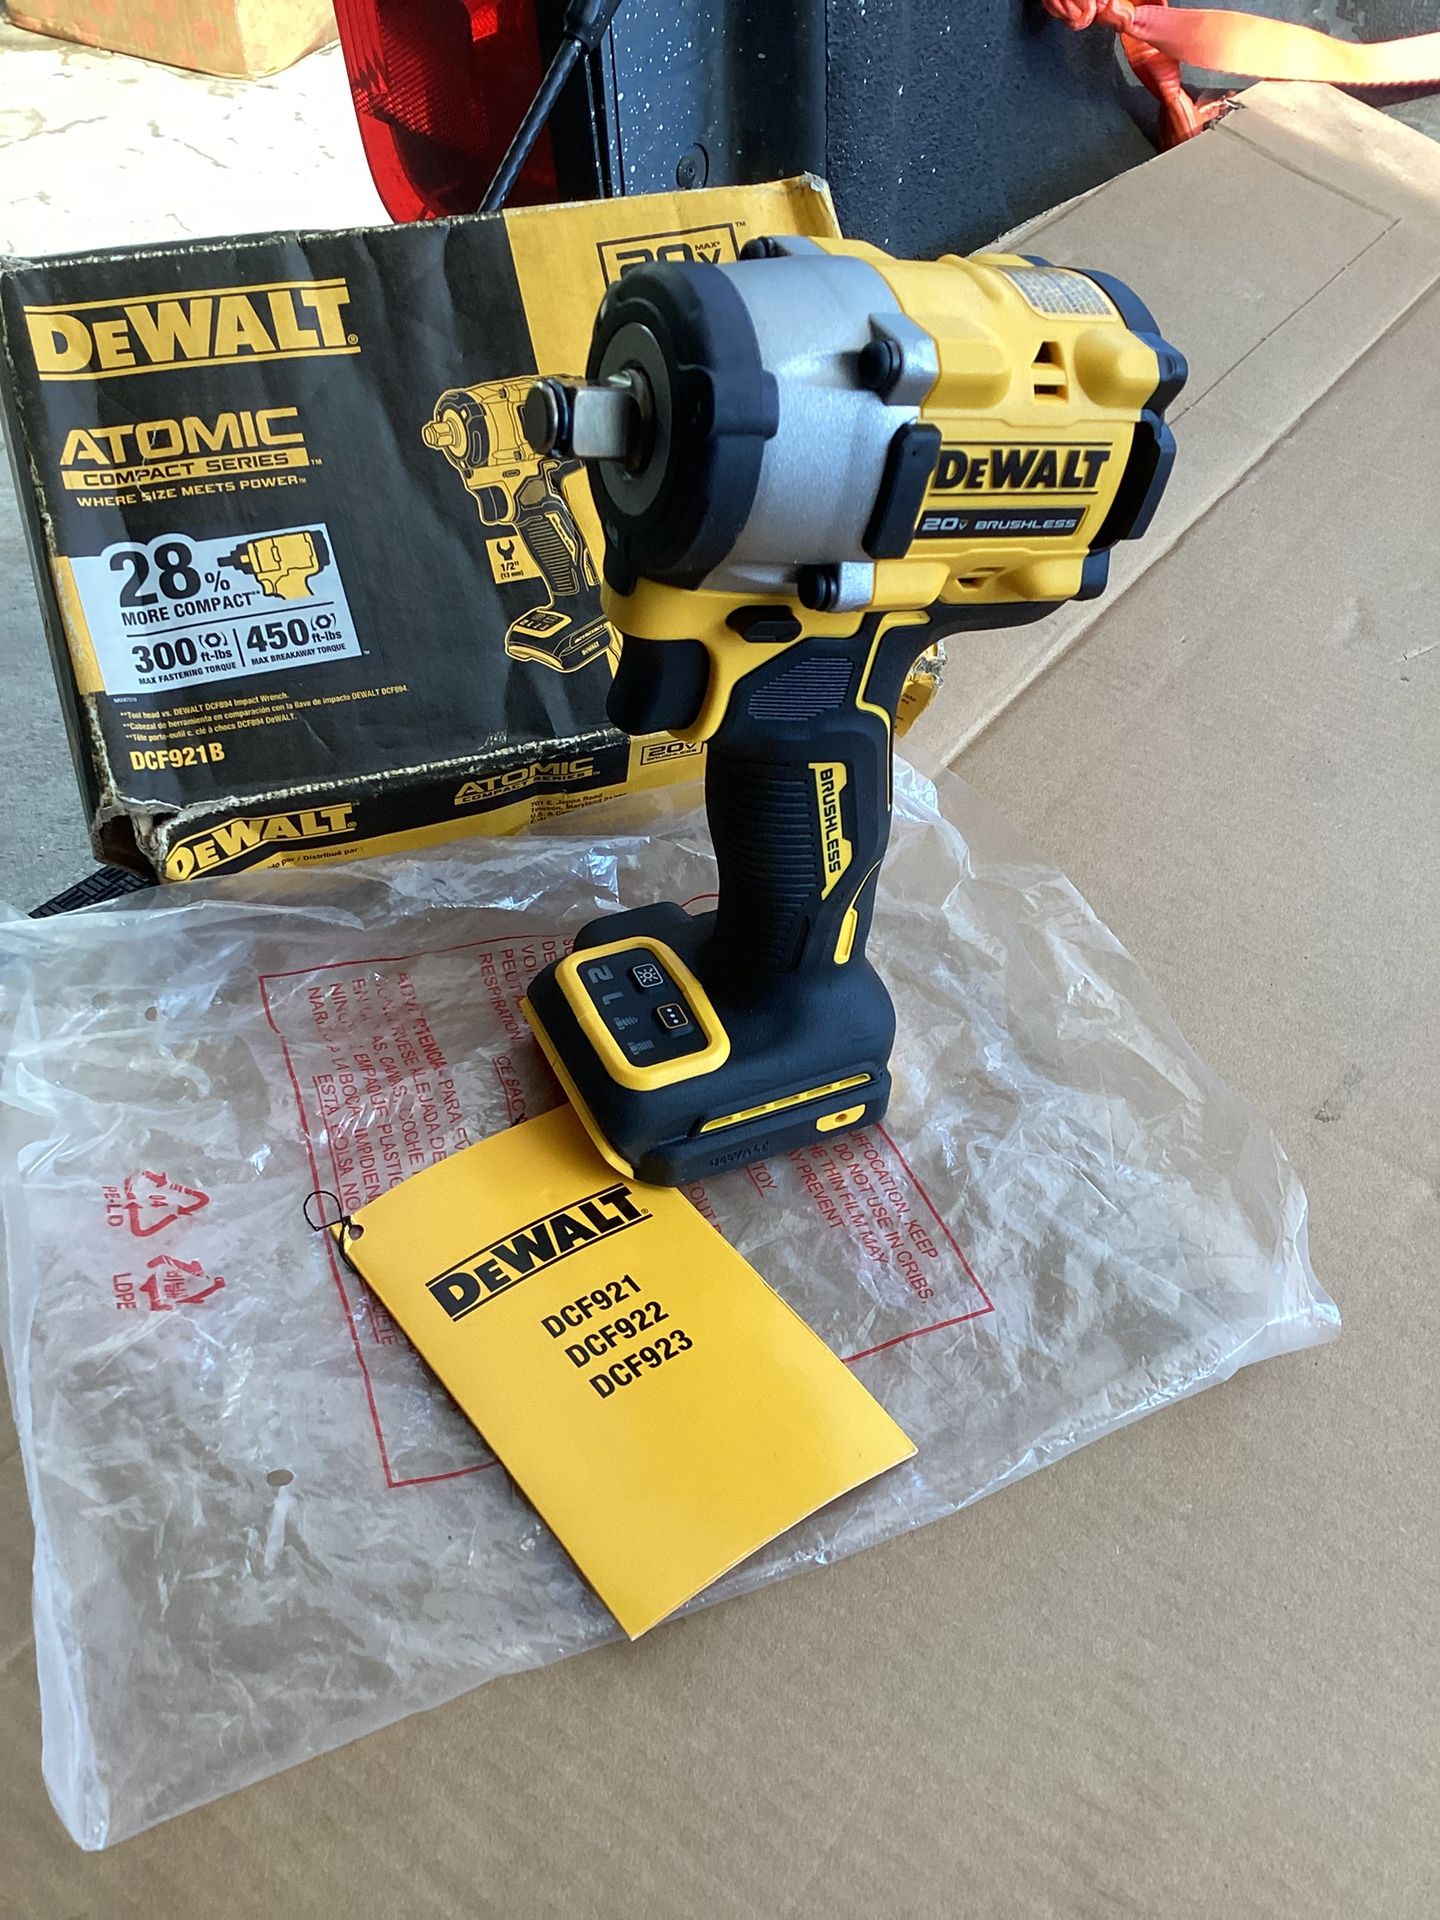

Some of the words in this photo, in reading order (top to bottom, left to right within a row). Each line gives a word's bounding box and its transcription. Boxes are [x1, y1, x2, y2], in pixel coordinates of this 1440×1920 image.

[60, 407, 304, 466] ATOMIC
[83, 462, 193, 487] COMPACT
[206, 453, 289, 473] SERIES
[77, 493, 137, 507] WHERE
[141, 487, 178, 502] SIZE
[181, 480, 236, 496] MEETS
[974, 519, 1078, 531] BRUSHLESS
[121, 607, 170, 626] MORE
[246, 618, 309, 652] 450
[311, 630, 342, 643] ft-lbs
[132, 637, 198, 673] 300
[200, 649, 233, 662] ft-lbs
[138, 677, 156, 685] MAX
[158, 668, 204, 683] FASTENING
[205, 662, 237, 674] TORQUE
[251, 657, 269, 666] MAX
[270, 649, 316, 662] BREAKAWAY
[317, 643, 346, 655] TORQUE
[129, 742, 225, 770] DCF921B
[456, 757, 594, 798] ATOMIC
[462, 781, 528, 803] COMPACT
[820, 767, 842, 874] BRUSHLESS
[500, 948, 522, 991] PEUT
[479, 953, 524, 1041] RESPIRATION
[438, 1079, 462, 1124] PARA
[317, 1074, 340, 1116] ESTA
[343, 1183, 361, 1211] NO
[752, 1162, 777, 1190] TOY
[797, 1166, 845, 1229] PREVENT
[821, 1159, 848, 1192] THIN
[839, 1192, 869, 1228] FILM
[860, 1230, 888, 1264] MAY
[832, 1142, 854, 1161] DO
[847, 1163, 875, 1193] NOT
[866, 1197, 894, 1230] USE
[885, 1231, 904, 1249] IN
[896, 1250, 934, 1304] CRIBS,
[904, 1219, 938, 1259] KEEP
[113, 1272, 137, 1311] LDPE
[540, 1273, 642, 1339] DCF921
[564, 1300, 670, 1369] DCF922
[588, 1329, 694, 1400] DCF923
